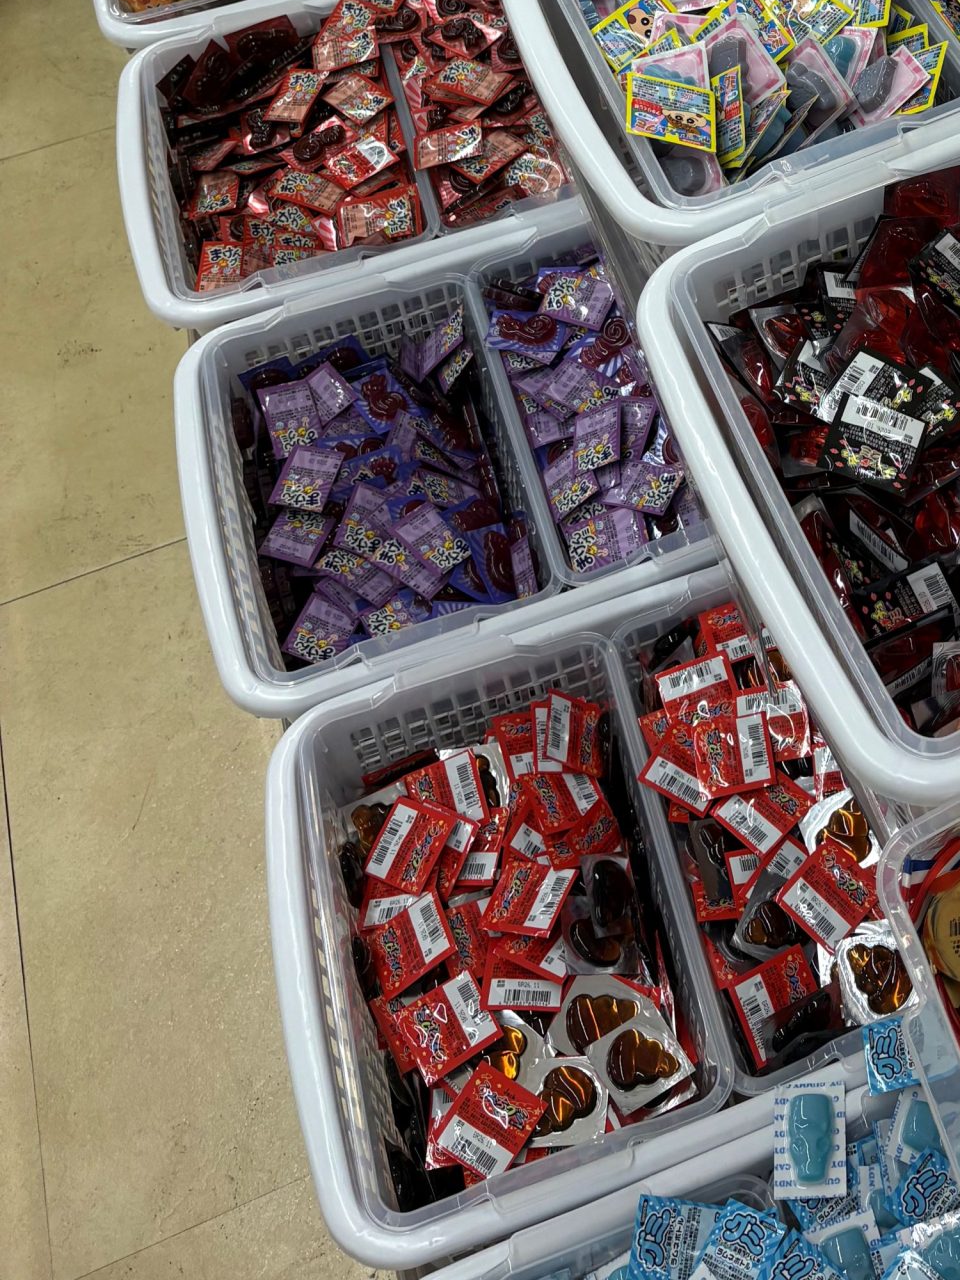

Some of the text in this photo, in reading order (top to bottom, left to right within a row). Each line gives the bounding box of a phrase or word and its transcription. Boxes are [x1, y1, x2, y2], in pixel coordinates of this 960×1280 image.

[289, 73, 319, 86] まけん
[872, 1026, 899, 1080] グミ
[902, 1166, 948, 1217] グミ
[635, 1205, 673, 1267] グミ
[718, 1207, 774, 1257] グミ
